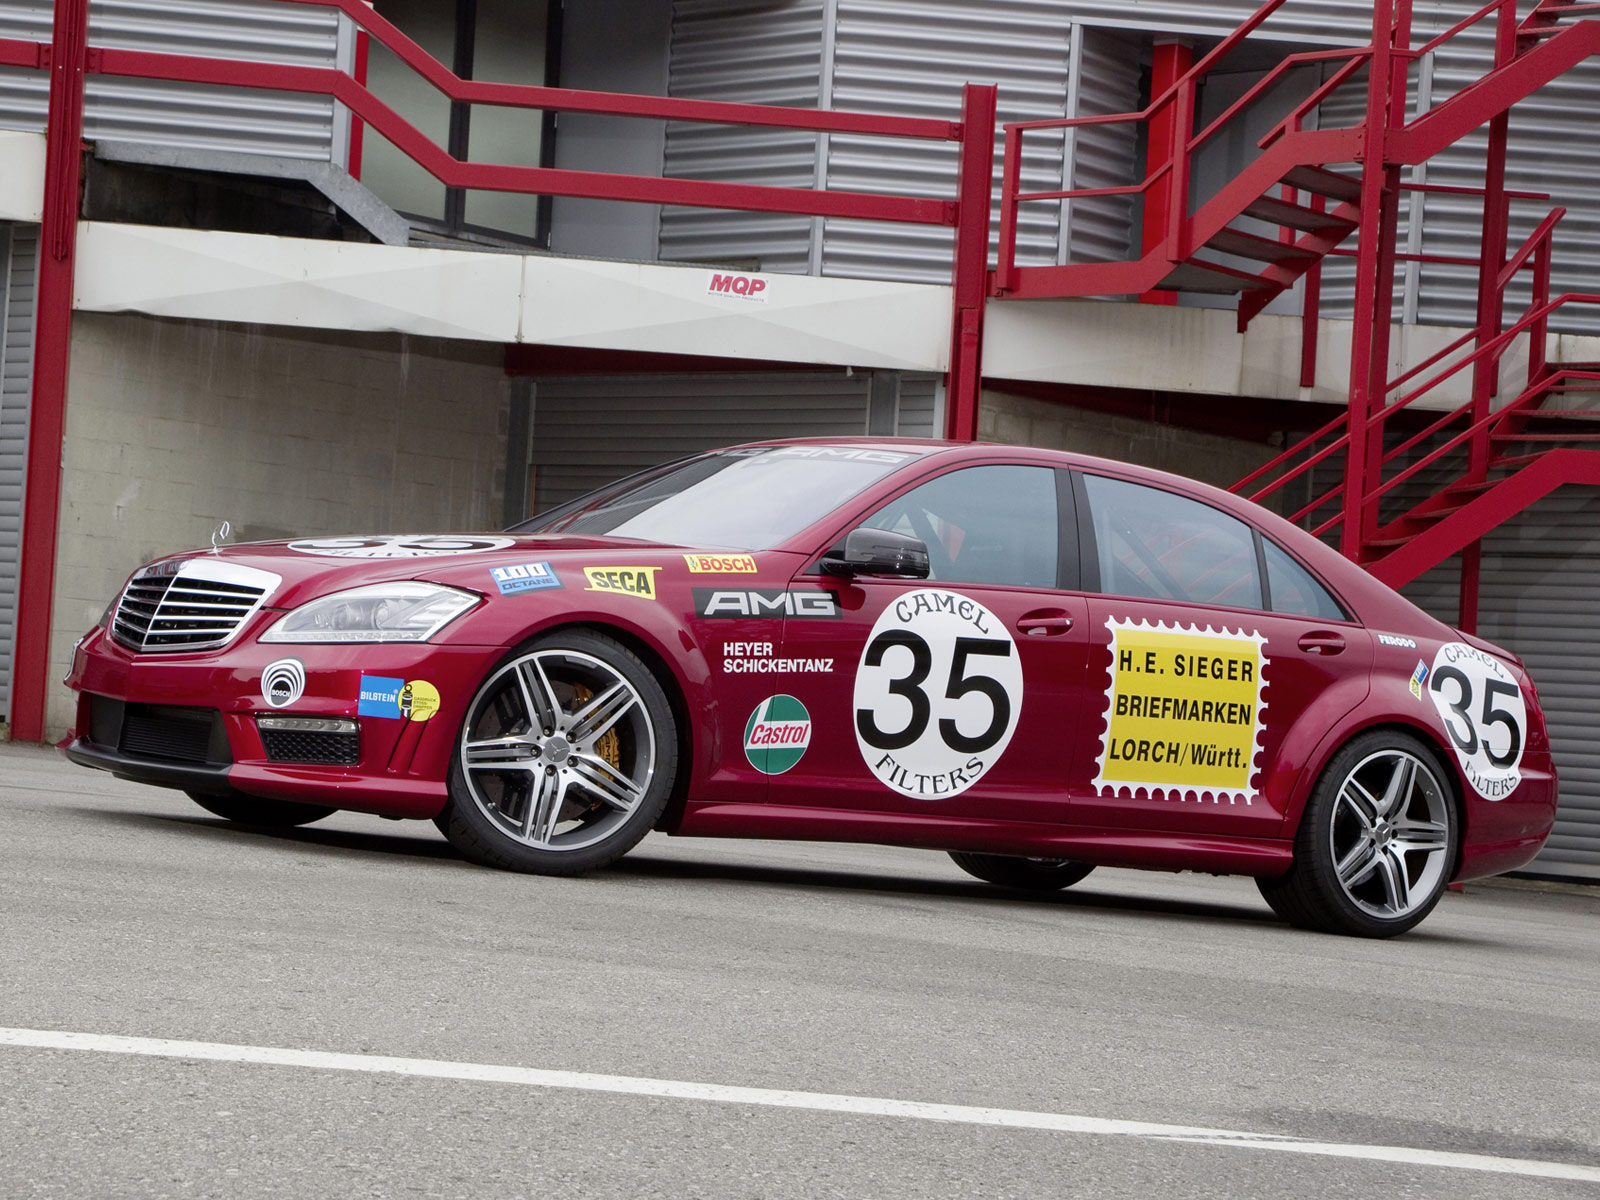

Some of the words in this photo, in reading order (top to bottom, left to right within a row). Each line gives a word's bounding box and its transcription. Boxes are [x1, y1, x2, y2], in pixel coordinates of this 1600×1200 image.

[709, 274, 766, 296] MQP
[493, 563, 548, 581] 100
[699, 558, 755, 571] BOSCH
[502, 578, 555, 591] OCTANE
[591, 571, 652, 594] SECA
[704, 591, 836, 616] AMG
[896, 593, 989, 635] CAMEL
[723, 642, 773, 656] HEYER
[1378, 634, 1417, 648] FERODO
[723, 659, 834, 673] SCHICKENTANZ
[1119, 649, 1165, 674] H.E.
[1174, 653, 1253, 682] SIEGER
[1444, 645, 1504, 678] CAMEL
[857, 629, 1011, 754] 35
[1115, 694, 1251, 725] BRIEFMARKEN
[1431, 665, 1520, 769] 35
[750, 723, 809, 745] Castrol
[1109, 738, 1247, 769] LORCH/Württ.
[874, 753, 984, 794] FILTERS
[1465, 761, 1517, 796] FILTERS
